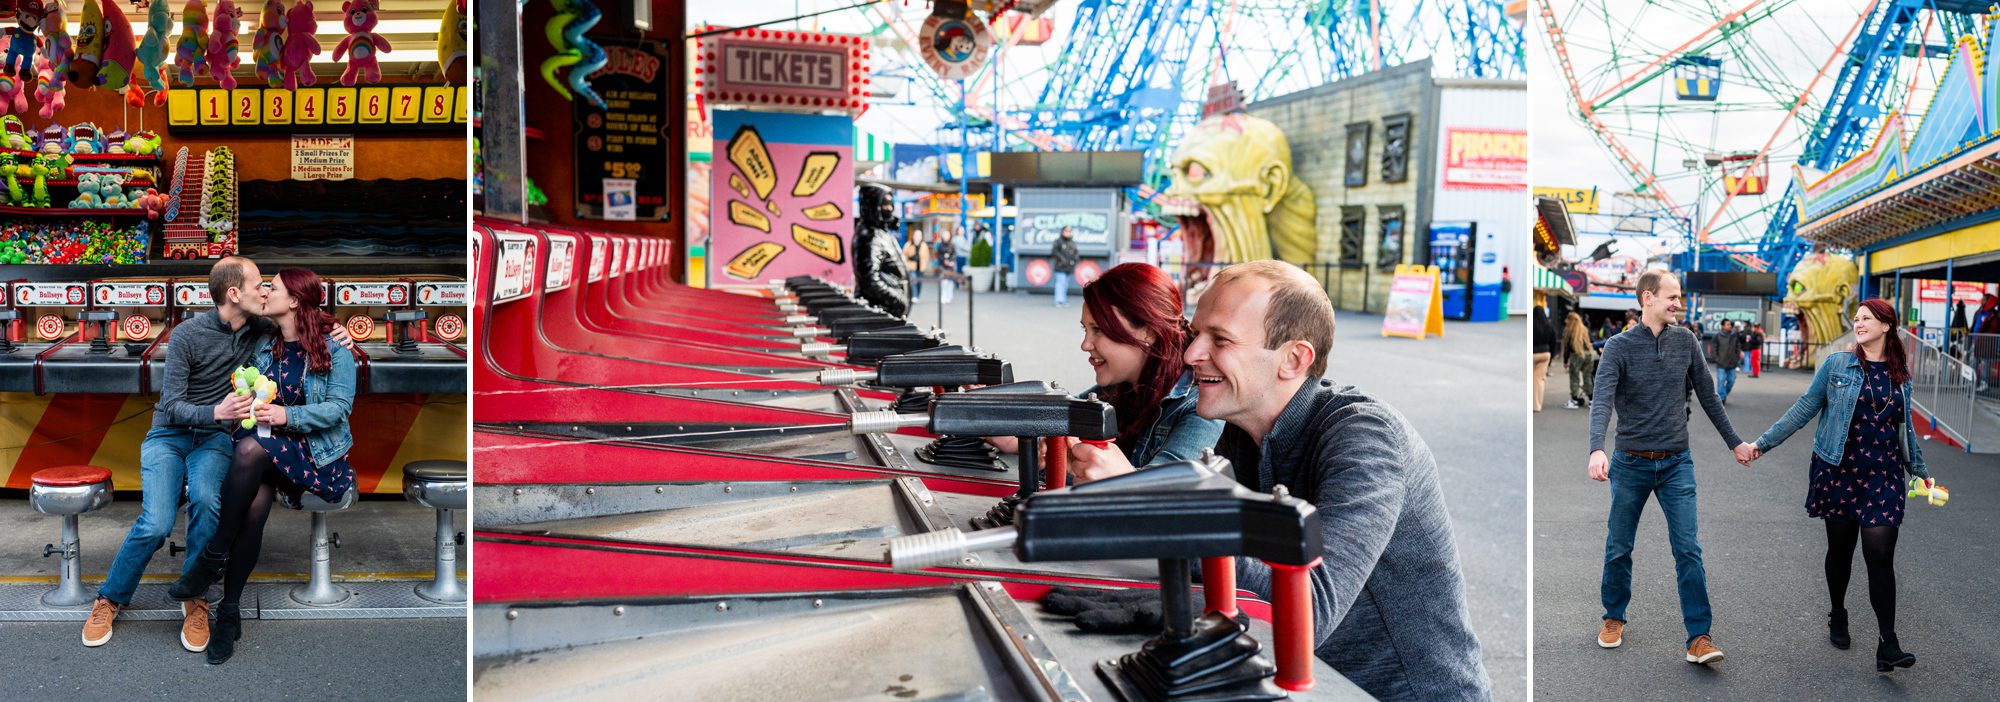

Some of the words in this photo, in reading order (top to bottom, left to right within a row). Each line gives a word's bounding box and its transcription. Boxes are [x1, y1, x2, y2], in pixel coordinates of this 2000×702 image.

[590, 45, 660, 83] ULES
[736, 50, 832, 85] TICKETS
[210, 97, 219, 118] 1
[241, 97, 251, 118] 2
[273, 96, 282, 117] 3
[304, 96, 314, 117] 4
[337, 96, 347, 117] 5
[369, 95, 379, 116] 6
[401, 95, 412, 116] 7
[433, 95, 444, 116] 8
[746, 157, 761, 179] ONE
[749, 148, 769, 179] ADMIT
[22, 290, 29, 301] 2
[39, 291, 63, 299] Bullseye
[101, 289, 108, 301] 3
[118, 291, 142, 299] Bullseye
[182, 290, 188, 302] 4
[343, 290, 349, 302] 6
[360, 291, 384, 299] Bullseye
[423, 290, 431, 301] 7
[440, 291, 465, 299] Bullseye
